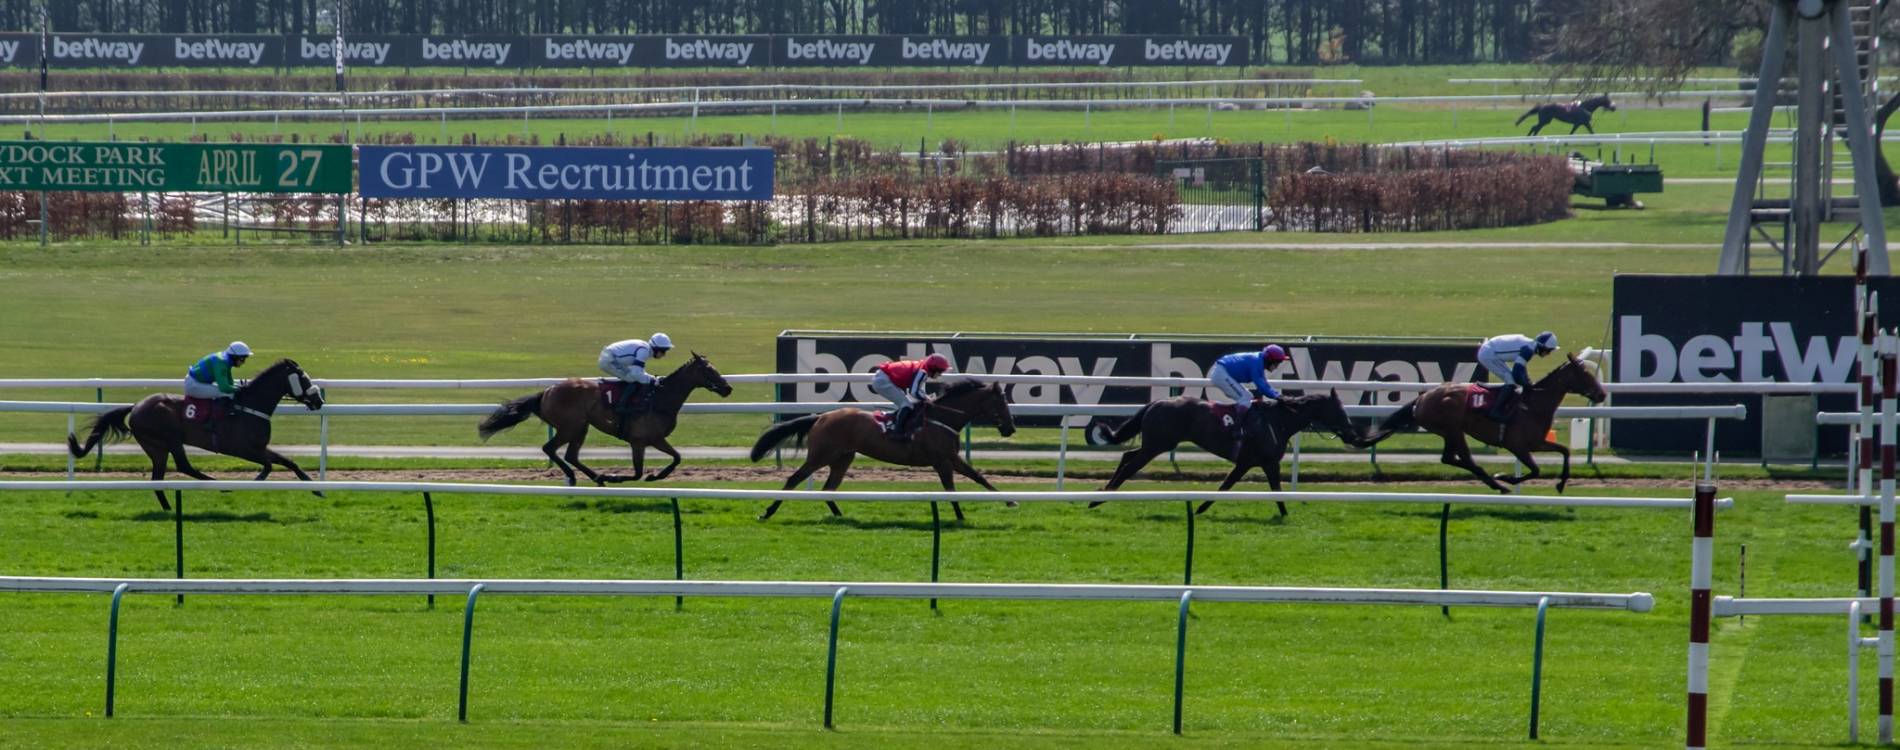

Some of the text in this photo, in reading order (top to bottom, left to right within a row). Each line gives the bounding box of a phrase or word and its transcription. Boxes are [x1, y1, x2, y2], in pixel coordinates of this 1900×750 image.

[54, 36, 144, 65] betway
[175, 37, 265, 65] betway
[423, 37, 511, 65] betway
[546, 38, 634, 65] betway
[666, 38, 754, 65] betway
[788, 38, 875, 65] betway
[903, 37, 991, 65] betway
[1028, 38, 1115, 65] betway
[1145, 39, 1233, 66] betway
[95, 147, 165, 165] PARK
[197, 150, 323, 187] APRIL 27
[41, 168, 165, 186] MEETING
[380, 151, 753, 192] GPW Recruitment
[606, 390, 612, 404] 1
[185, 404, 196, 418] 6
